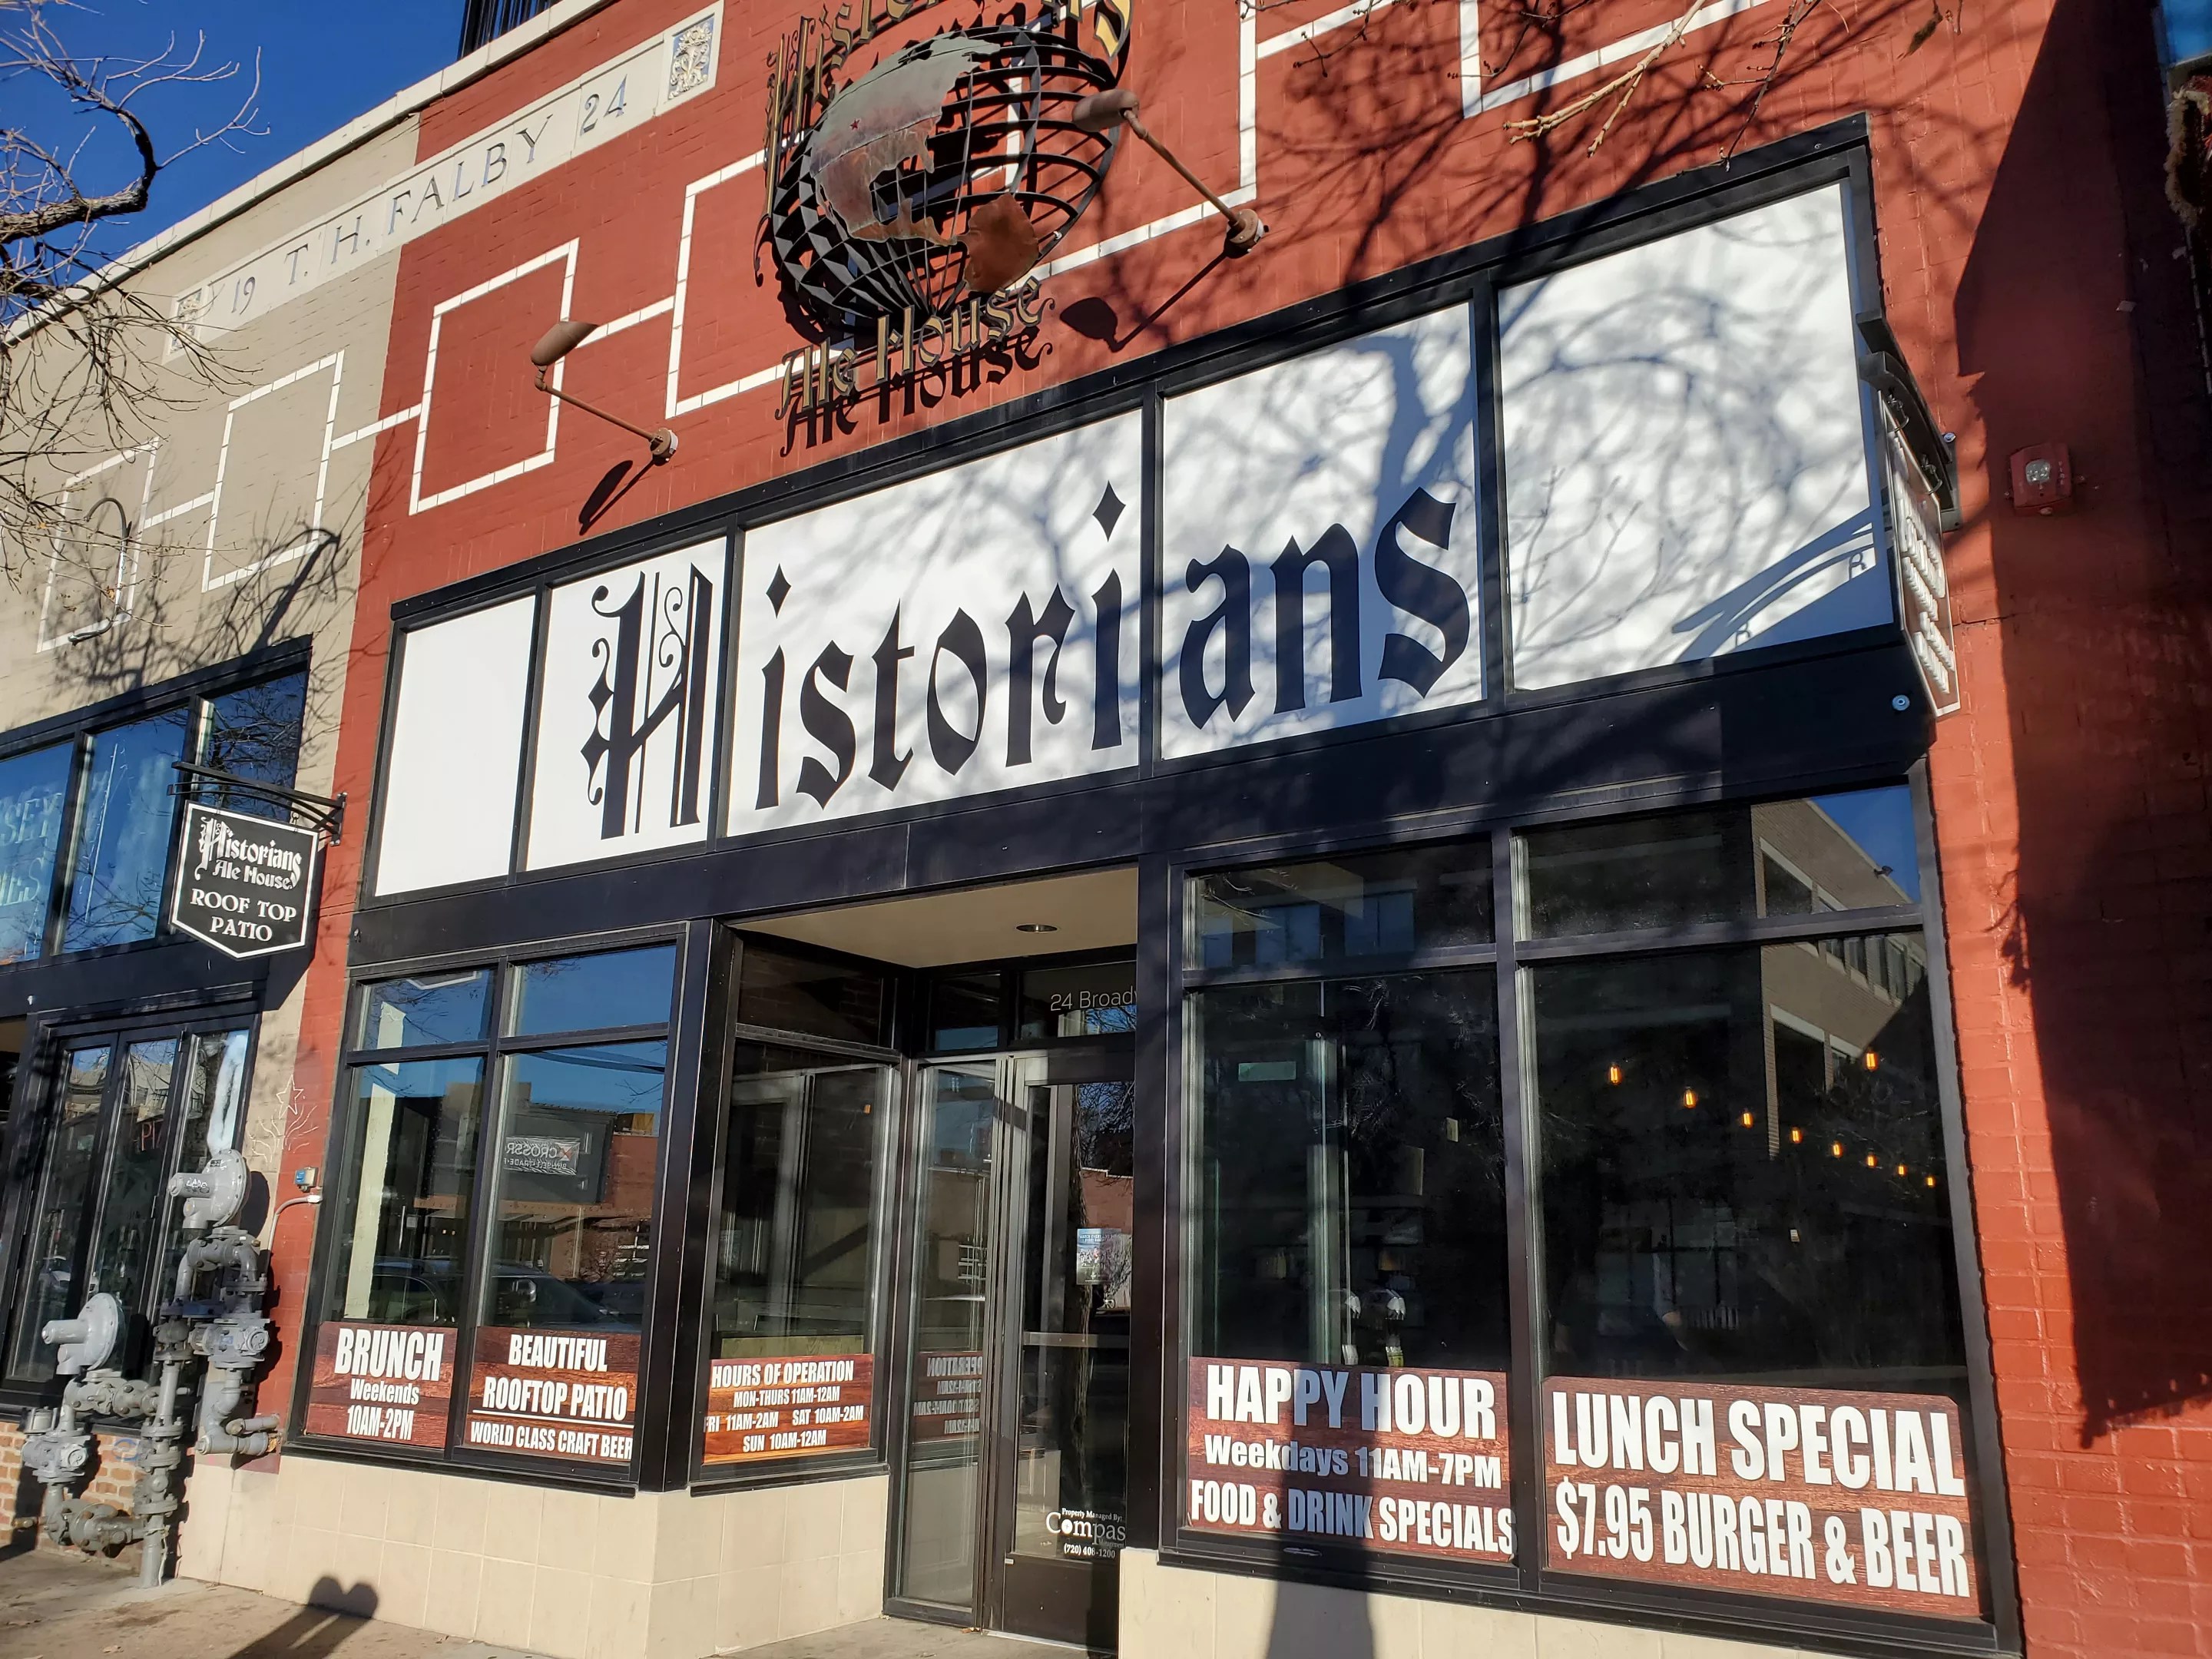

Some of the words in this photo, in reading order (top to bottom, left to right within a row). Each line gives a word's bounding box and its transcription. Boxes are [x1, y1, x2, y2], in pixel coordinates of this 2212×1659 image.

[230, 276, 256, 315] 19
[283, 242, 309, 285] T.
[330, 215, 370, 266] H.
[388, 113, 554, 235] FALBY
[579, 73, 628, 134] 24
[775, 336, 859, 420] Ale
[876, 276, 1055, 383] House
[581, 480, 1472, 841] Historians
[194, 816, 302, 887] Historians
[212, 859, 241, 880] Ale
[243, 865, 293, 889] House
[190, 889, 250, 914] ROOF
[257, 900, 297, 922] TOP
[210, 916, 273, 942] PATIO
[1050, 992, 1073, 1012] 24
[334, 1328, 445, 1381] BRUNCH
[508, 1333, 608, 1373] BEAUTIFUL
[350, 1378, 420, 1406] Weekends
[711, 1364, 761, 1388] HOURS
[763, 1363, 782, 1385] OF
[783, 1360, 855, 1383] OPERATION
[482, 1376, 567, 1416] ROOFTOP
[570, 1382, 628, 1421] PATIO
[733, 1387, 790, 1409] MON-THURS
[791, 1386, 841, 1404] 11AM-12AM
[1207, 1364, 1349, 1429] HAPPY
[1361, 1373, 1497, 1440] HOUR
[346, 1408, 415, 1440] 10AM-2PM
[704, 1416, 720, 1433] FRI
[726, 1412, 780, 1432] 11AM-2AM
[792, 1409, 810, 1426] SAT
[814, 1406, 864, 1425] 10AM-2AM
[471, 1422, 514, 1446] WORLD
[515, 1426, 555, 1451] CLASS
[558, 1430, 599, 1456] CRAFT
[600, 1434, 633, 1460] BEER
[743, 1434, 766, 1453] SUN
[770, 1429, 827, 1450] 10AM-12AM
[1552, 1391, 1717, 1476] LUNCH
[1728, 1400, 1966, 1497] SPECIAL
[1204, 1435, 1349, 1476] Weekdays
[1355, 1446, 1502, 1489] 11AM-7PM
[1062, 1508, 1084, 1519] Property
[1086, 1511, 1111, 1522] Managed
[1190, 1479, 1257, 1526] FOOD
[1262, 1492, 1282, 1529] &
[1288, 1488, 1374, 1539] DRINK
[1379, 1496, 1517, 1555] SPECIALS
[1064, 1542, 1081, 1556] (720)
[1083, 1546, 1116, 1558] 408-1200
[1555, 1476, 1654, 1562] $7.95
[1661, 1490, 1816, 1580] BURGER
[1824, 1516, 1857, 1585] &
[1861, 1508, 1971, 1598] BEER
